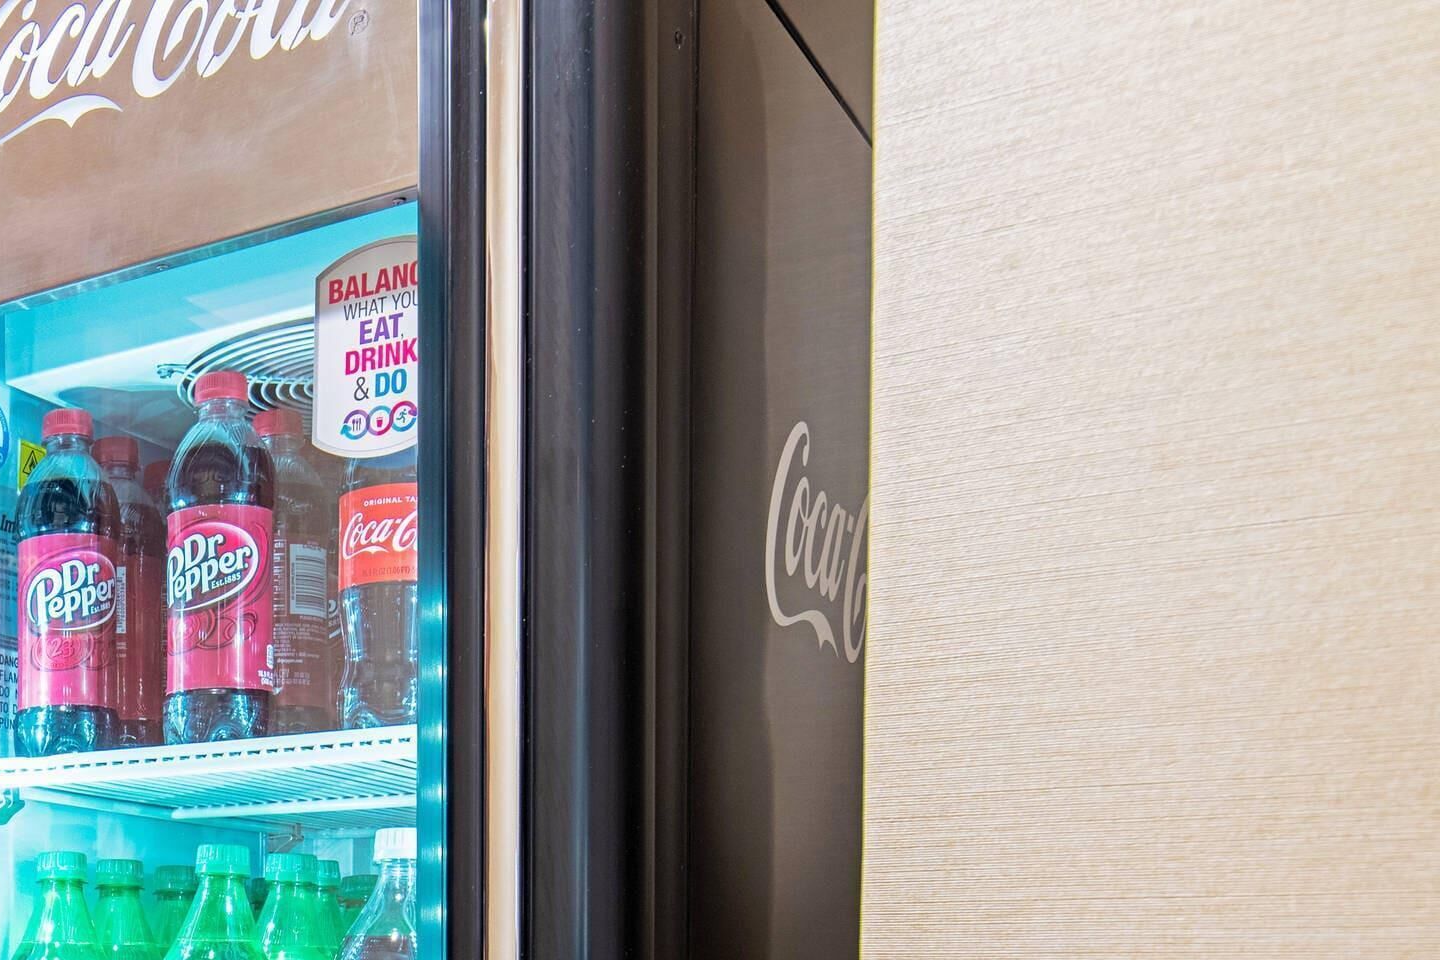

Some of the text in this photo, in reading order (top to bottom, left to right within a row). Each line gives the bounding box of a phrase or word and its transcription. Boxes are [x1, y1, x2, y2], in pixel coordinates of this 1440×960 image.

[344, 297, 387, 320] WHAT
[360, 313, 404, 345] EAT,
[345, 338, 418, 375] DRINK
[354, 368, 407, 401] & DO
[364, 497, 402, 507] ORIGINAL
[183, 534, 225, 571] Dr
[343, 512, 417, 560] Coca-C
[61, 560, 100, 593] Dr
[27, 568, 115, 627] Pepper
